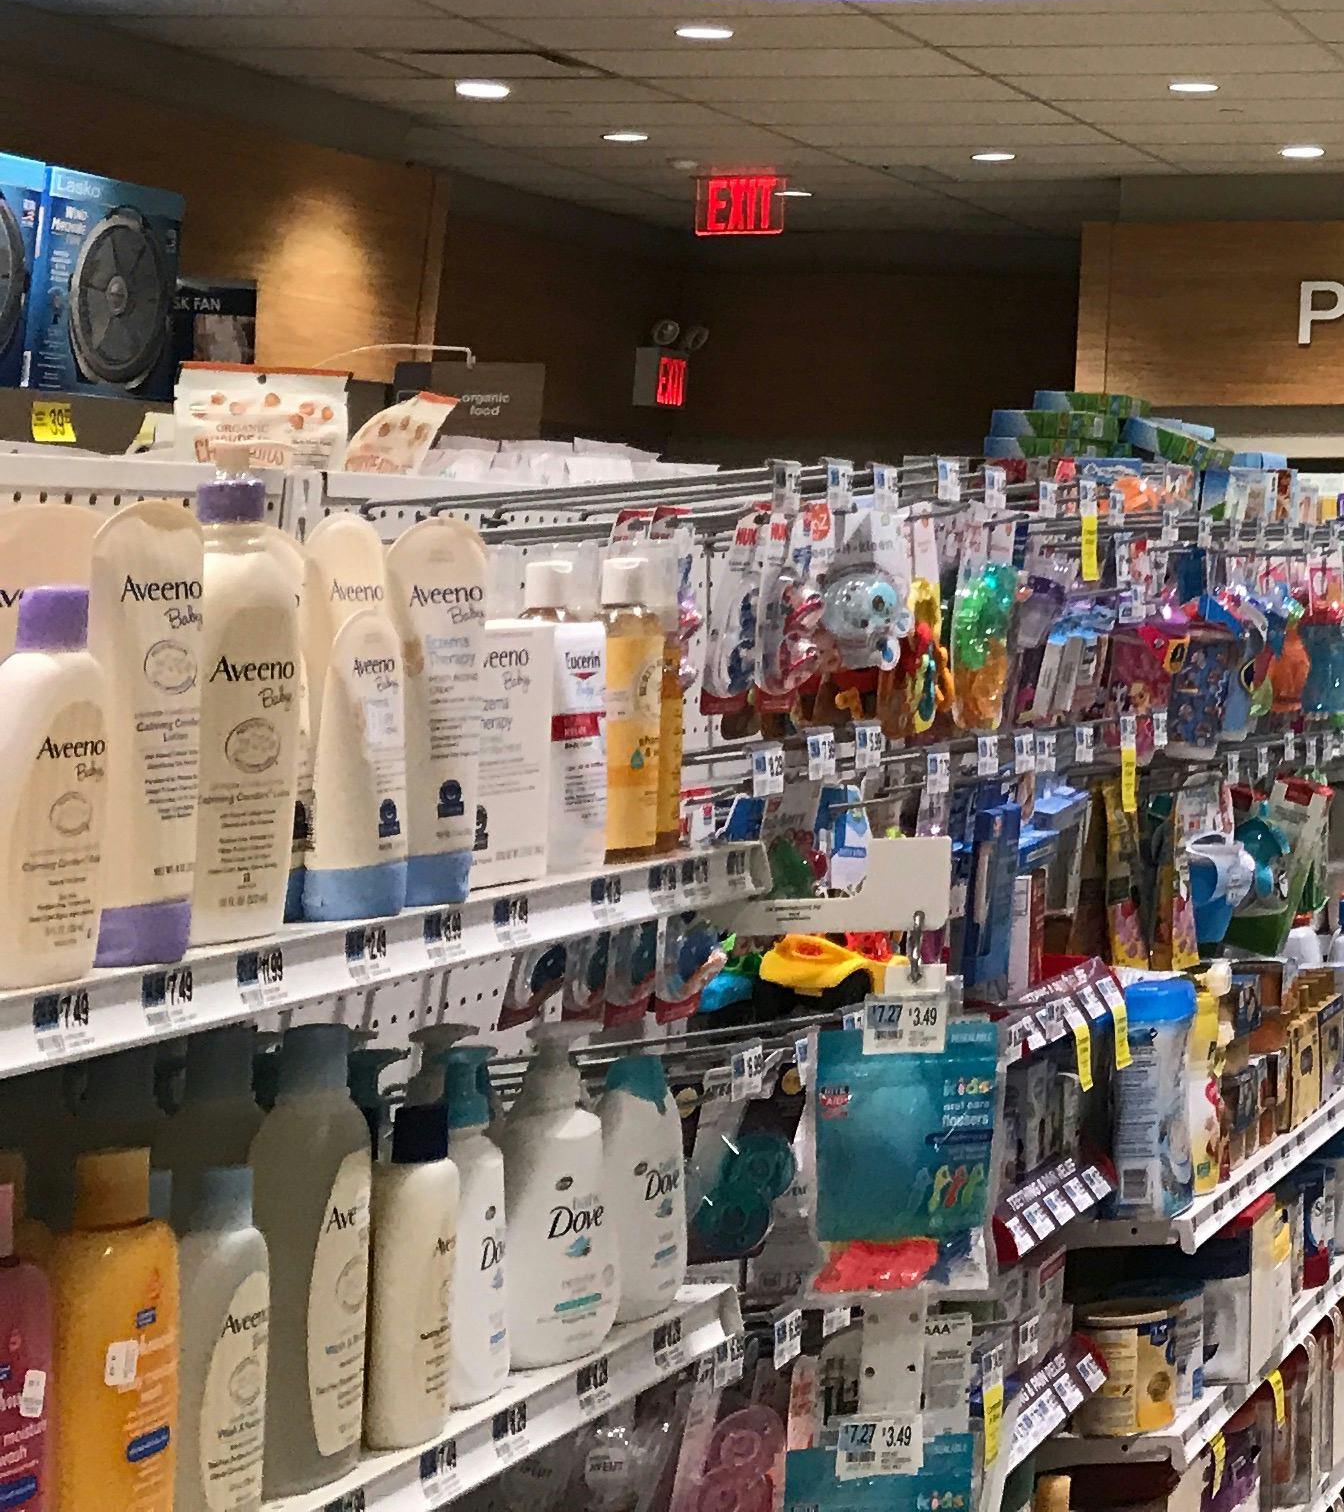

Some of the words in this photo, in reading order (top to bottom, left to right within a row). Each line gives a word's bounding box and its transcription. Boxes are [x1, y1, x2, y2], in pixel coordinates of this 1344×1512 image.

[707, 178, 777, 230] EXIT
[194, 296, 221, 312] FAN
[656, 356, 687, 407] EXIT
[461, 392, 511, 405] organic
[470, 404, 501, 416] food
[120, 575, 203, 603] Aveeno
[329, 578, 385, 603] Aveeno
[409, 584, 483, 608] Aveeno
[209, 656, 295, 683] Aveeno
[36, 736, 106, 760] Aveeno
[547, 1205, 604, 1240] Dove
